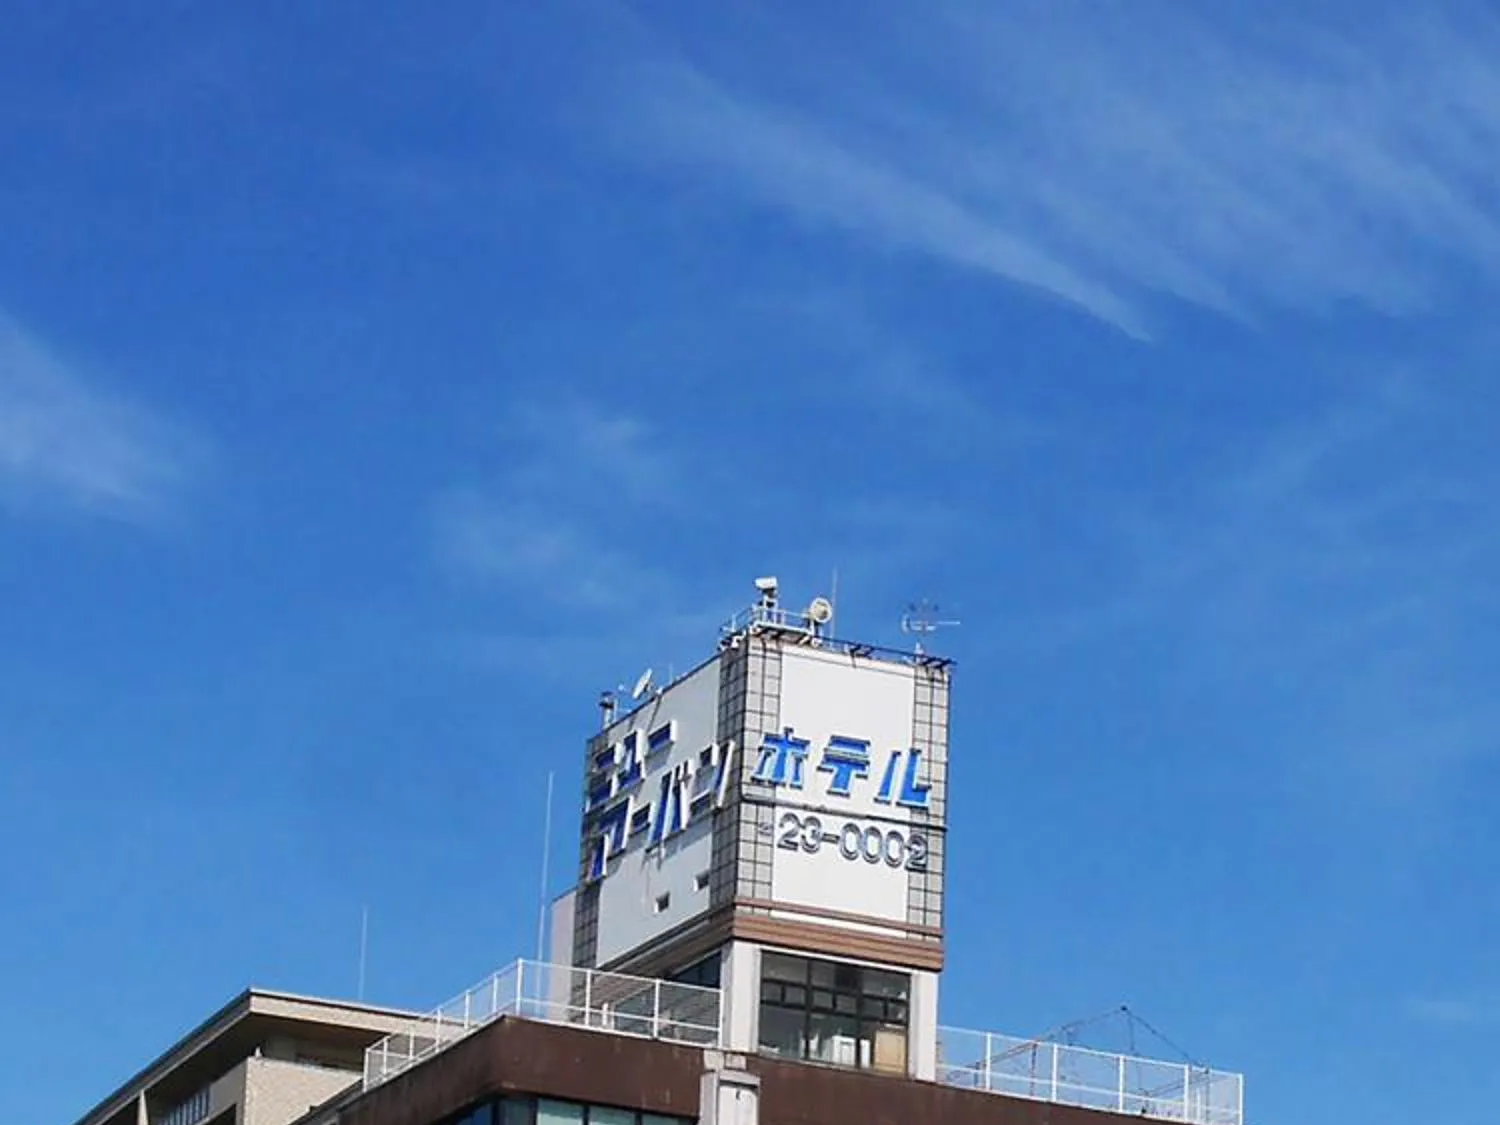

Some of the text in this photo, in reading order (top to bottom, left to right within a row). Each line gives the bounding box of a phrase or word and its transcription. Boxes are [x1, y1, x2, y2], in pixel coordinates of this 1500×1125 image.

[750, 727, 932, 808] ホテル
[777, 812, 929, 873] 23-0002
